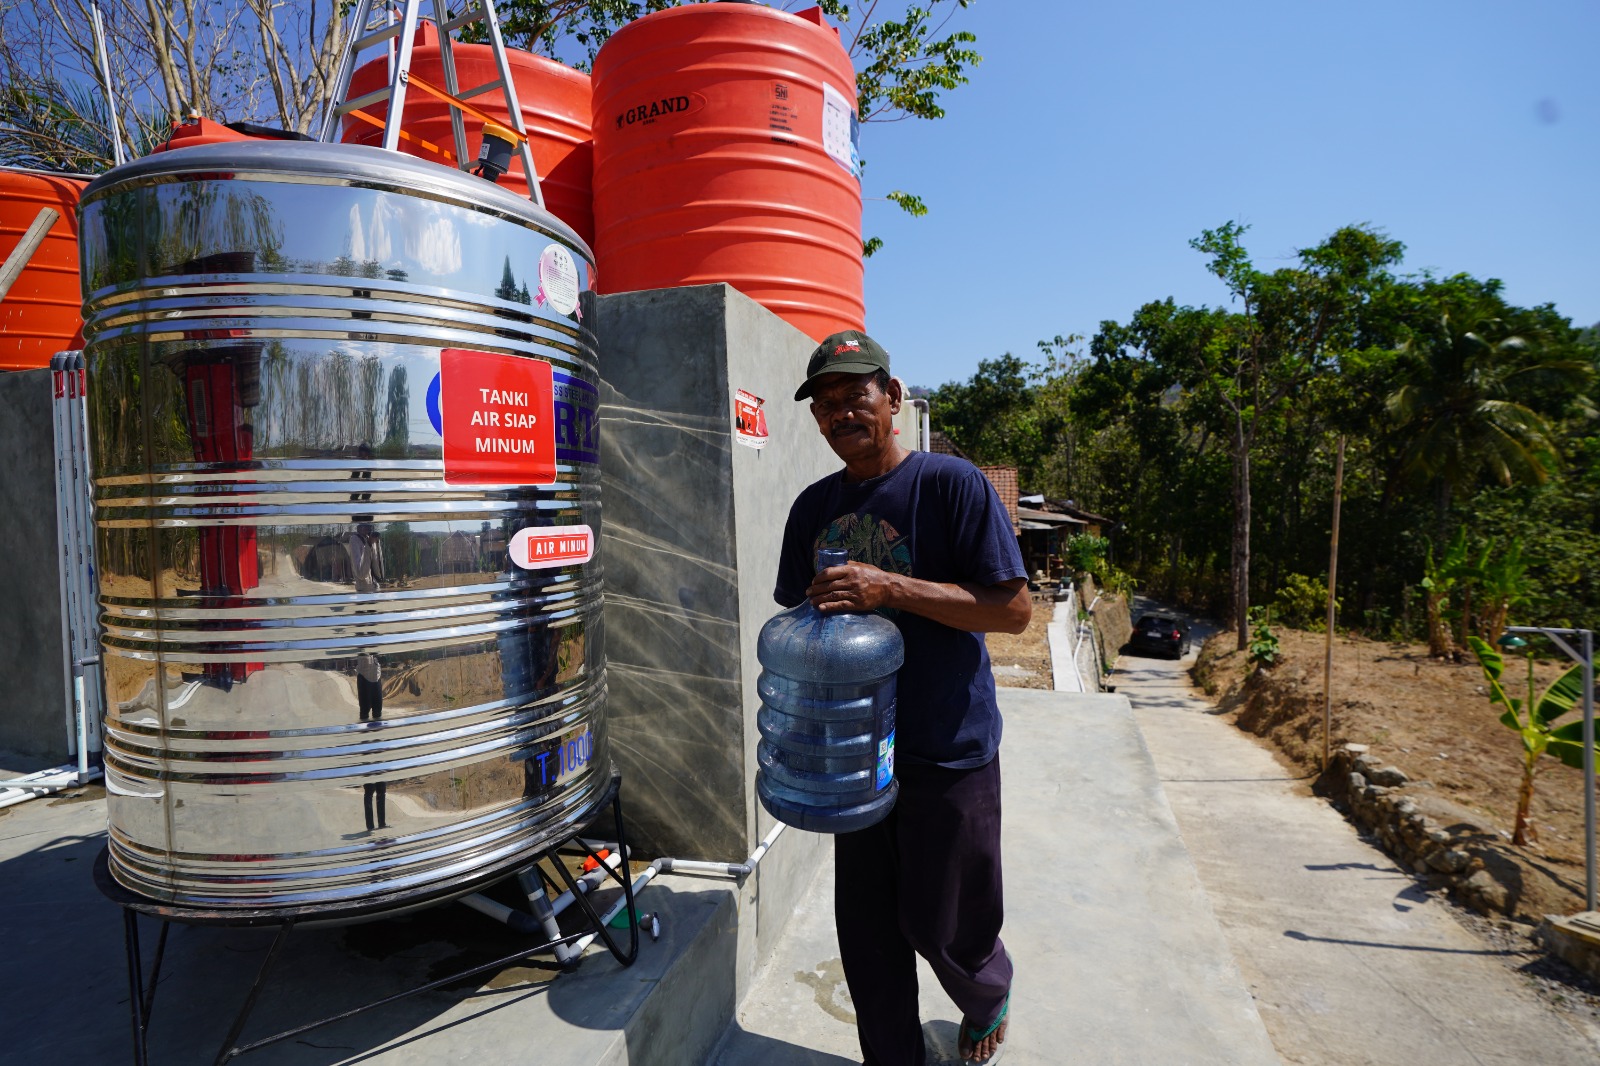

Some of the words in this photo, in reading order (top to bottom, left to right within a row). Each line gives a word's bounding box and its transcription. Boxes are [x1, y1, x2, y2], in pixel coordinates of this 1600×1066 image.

[775, 86, 788, 99] SNI
[626, 96, 690, 124] GRAND
[479, 388, 528, 408] TANKI
[470, 411, 501, 427] AIR
[504, 413, 537, 429] SIAP
[475, 438, 535, 454] MINUM
[536, 541, 555, 555] AIR
